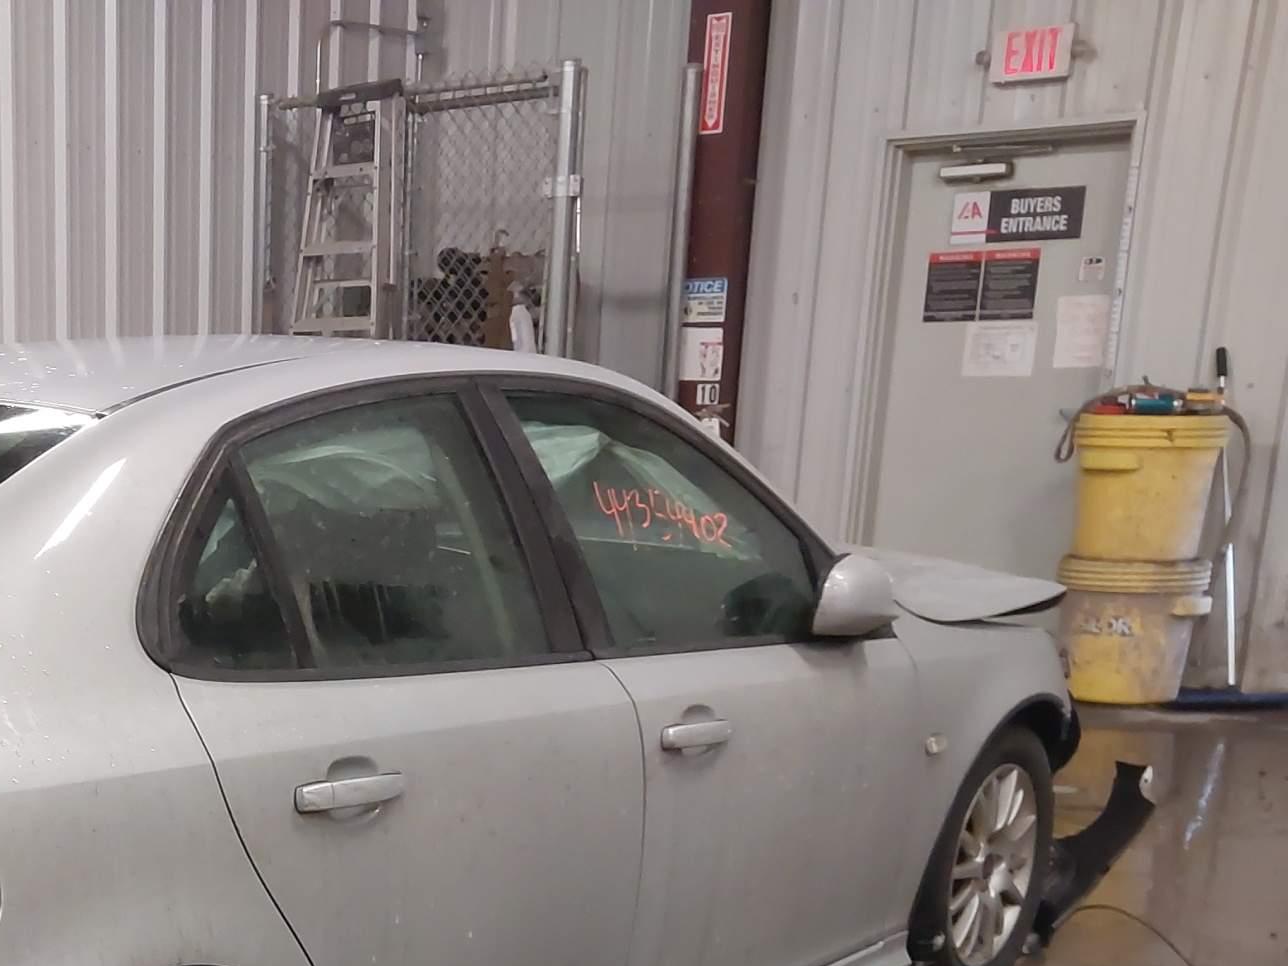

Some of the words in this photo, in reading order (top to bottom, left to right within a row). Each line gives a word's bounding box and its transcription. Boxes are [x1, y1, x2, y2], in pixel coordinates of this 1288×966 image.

[1004, 27, 1063, 75] EXIT
[1010, 196, 1062, 214] BUYERS
[1000, 214, 1068, 234] ENTRANCE
[683, 280, 723, 293] OTICE
[701, 385, 716, 403] 10
